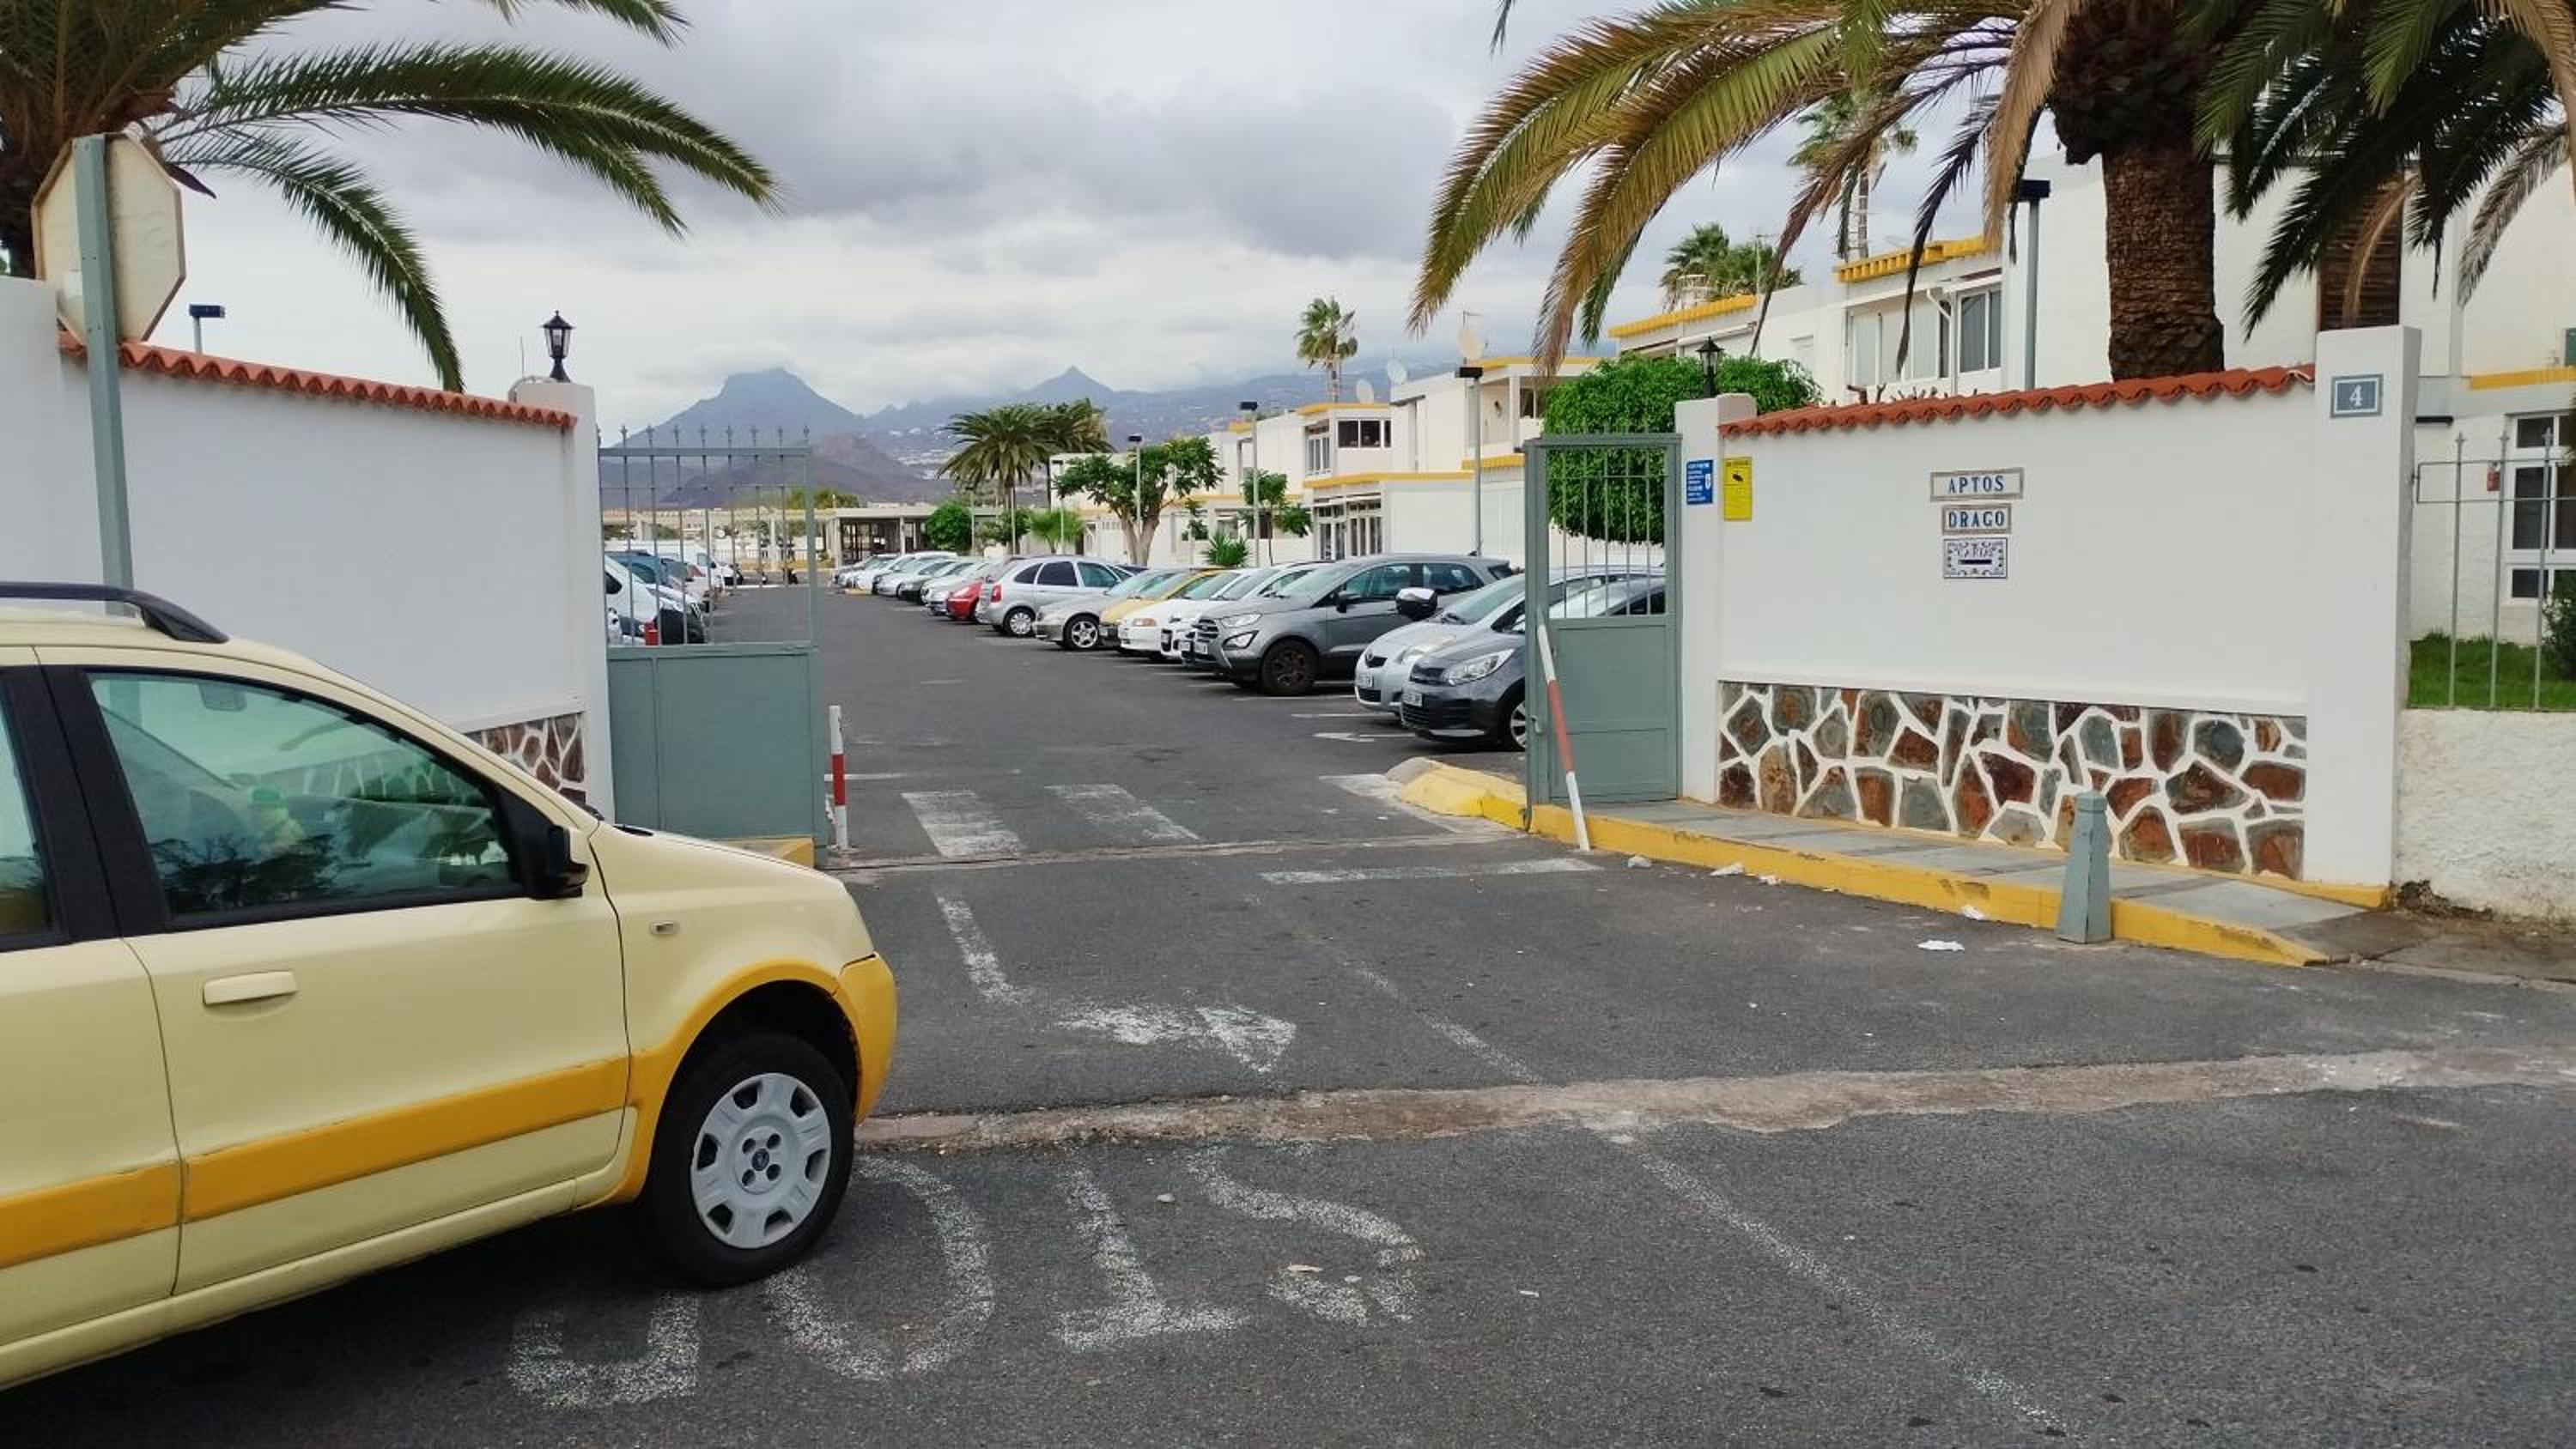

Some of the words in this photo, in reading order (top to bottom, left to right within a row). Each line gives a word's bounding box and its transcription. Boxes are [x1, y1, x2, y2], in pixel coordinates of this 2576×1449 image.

[2349, 384, 2363, 407] 4
[1948, 475, 2005, 494] APTOS
[1947, 510, 2005, 528] DRAGO
